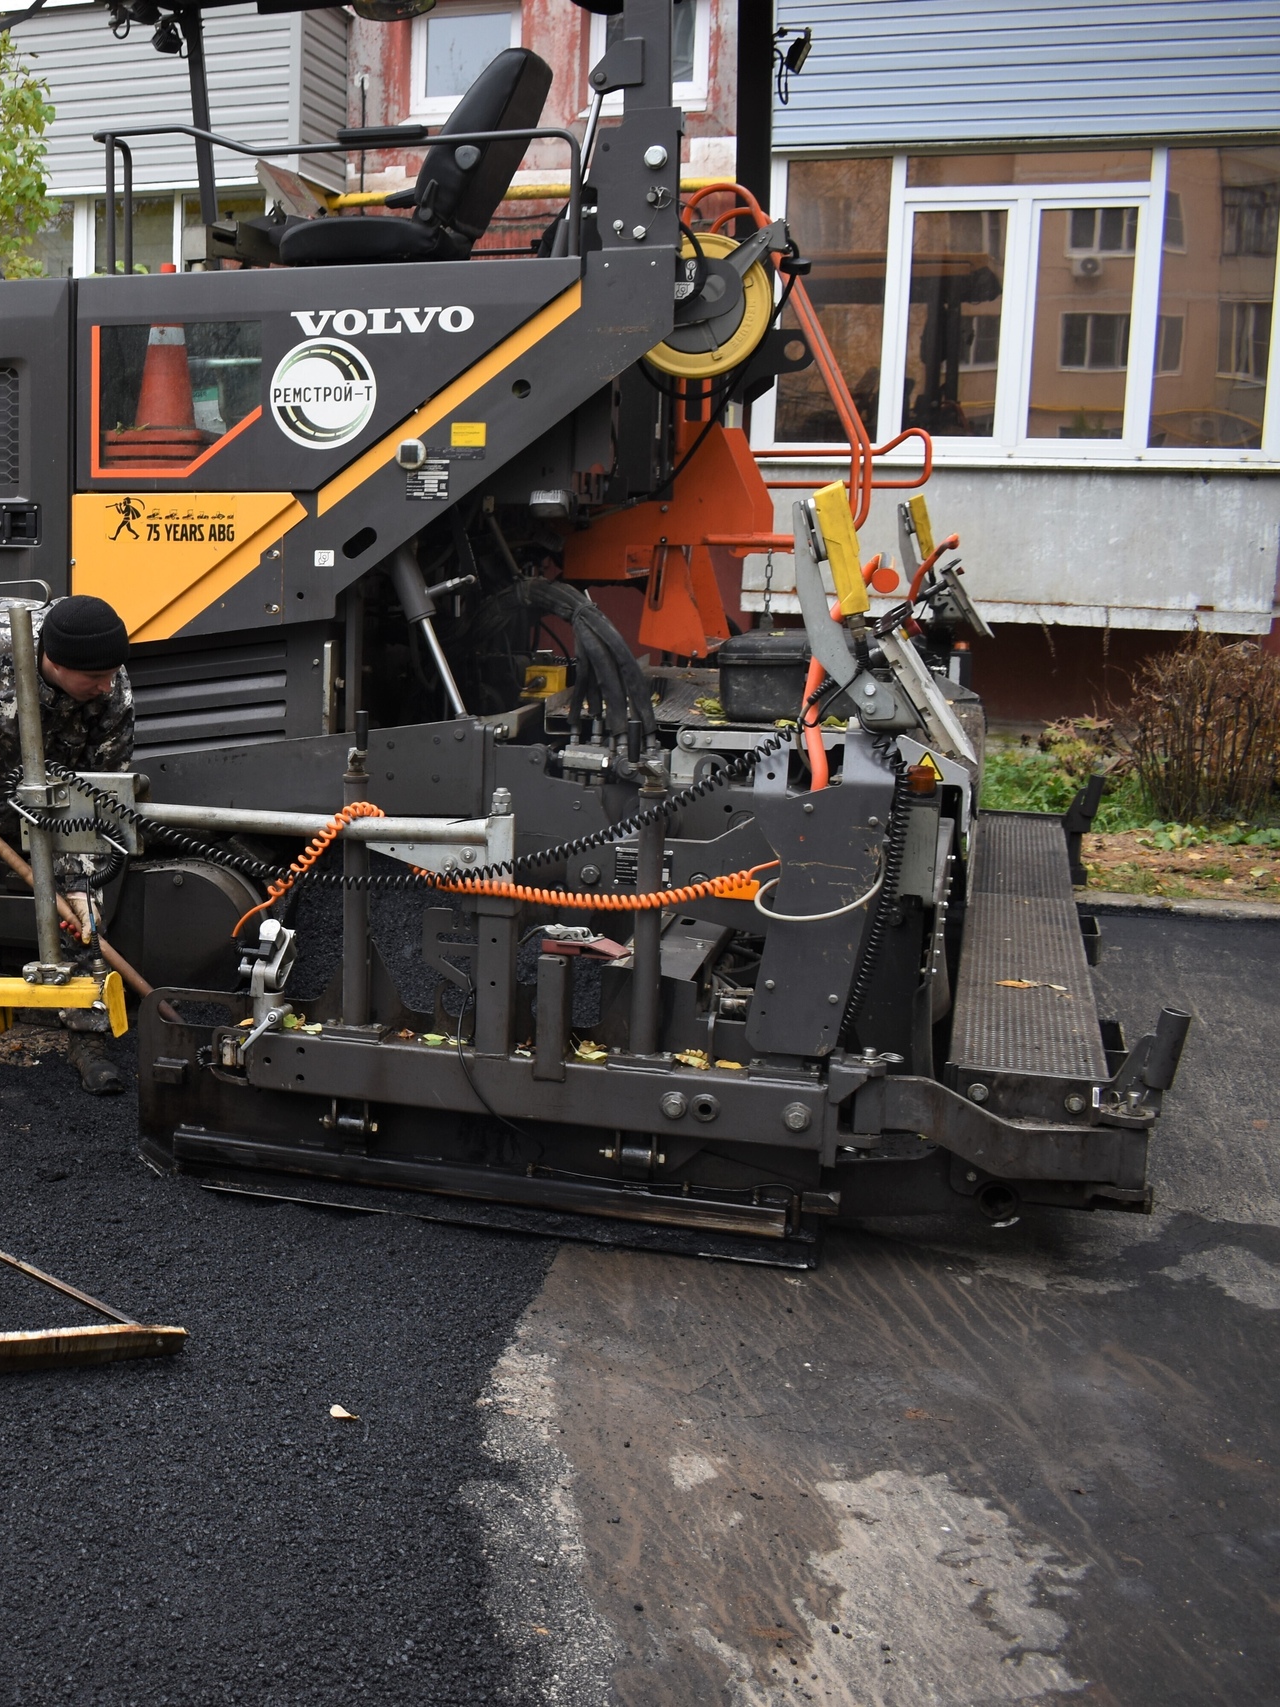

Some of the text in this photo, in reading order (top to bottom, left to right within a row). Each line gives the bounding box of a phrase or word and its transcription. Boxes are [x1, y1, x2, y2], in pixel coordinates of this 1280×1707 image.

[290, 305, 475, 336] VOLVO
[273, 382, 373, 403] РЕМСТРОЙ-Т
[146, 523, 235, 541] 75 YEARS ABG
